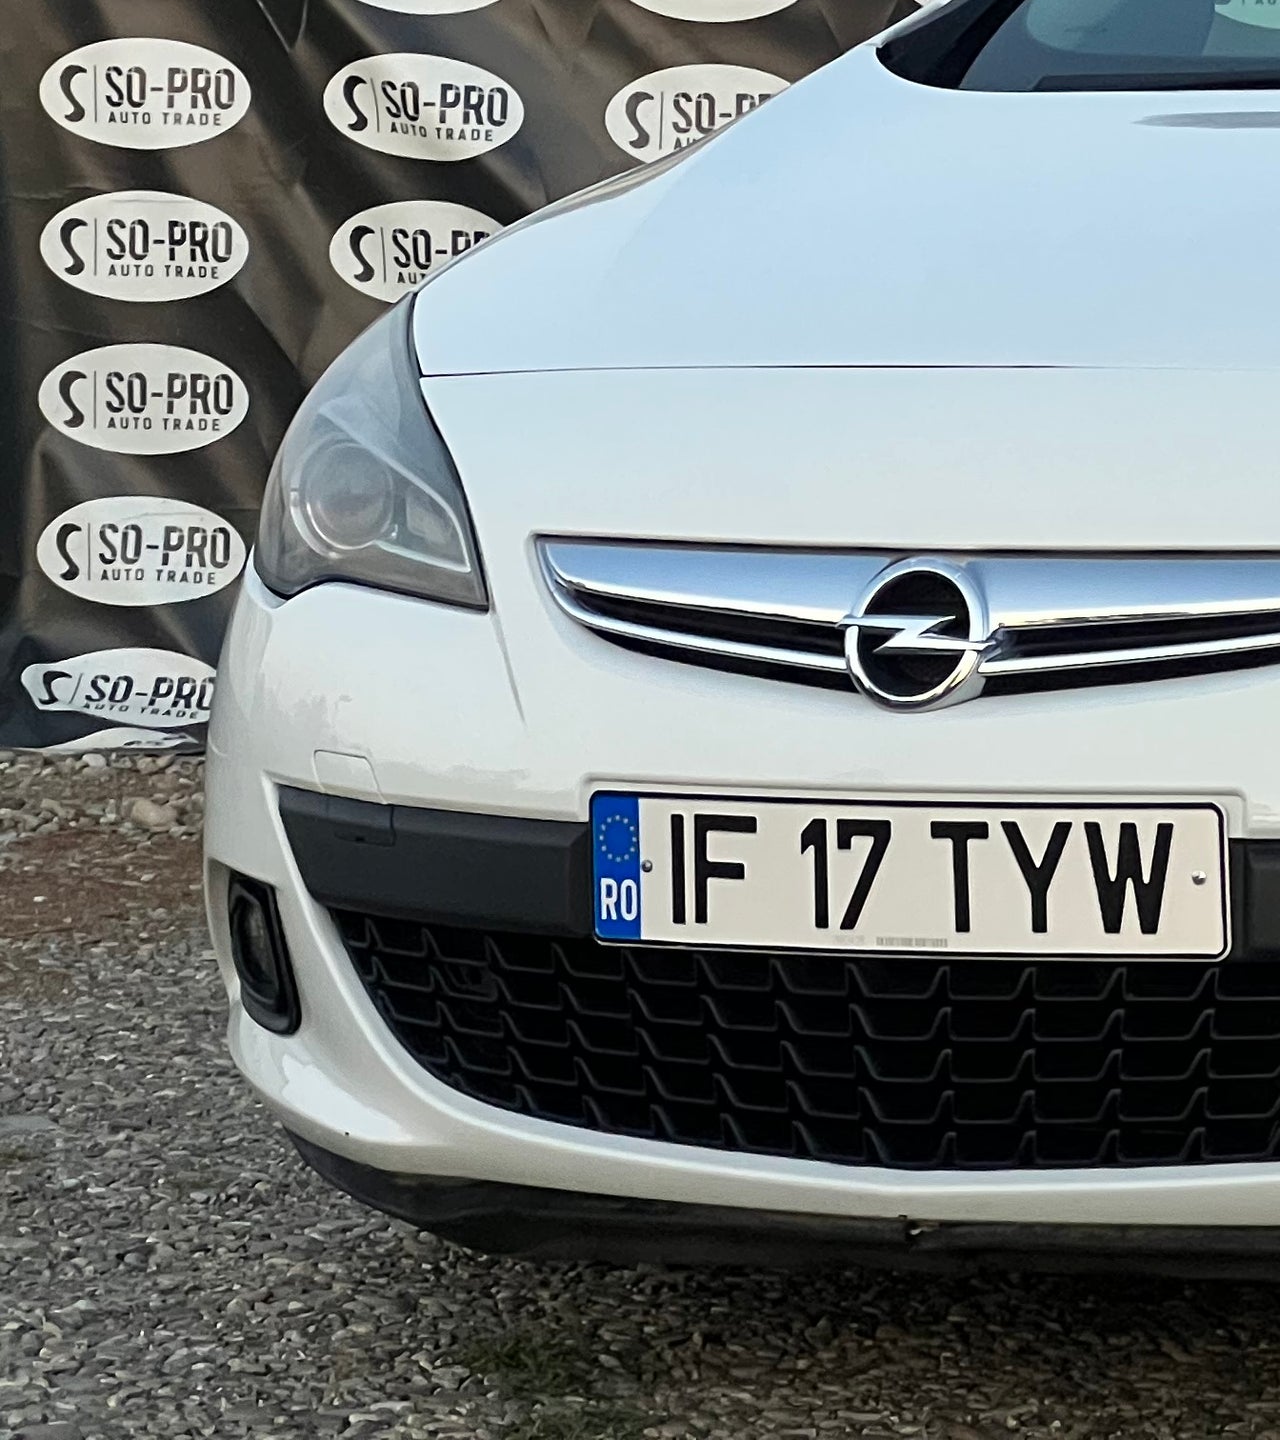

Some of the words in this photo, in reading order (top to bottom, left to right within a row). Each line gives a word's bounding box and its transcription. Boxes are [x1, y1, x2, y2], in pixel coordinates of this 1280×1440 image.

[104, 65, 235, 109] SO-PRO
[379, 79, 509, 127] SO-PRO
[109, 112, 150, 124] AUTO
[163, 112, 221, 126] TRADE
[391, 119, 427, 137] AUTO
[435, 127, 492, 141] TRADE
[672, 92, 773, 134] SO-P
[105, 218, 233, 263] SO-PRO
[392, 228, 490, 270] SO-P
[109, 265, 153, 276] AUTO
[165, 265, 218, 279] TRADE
[104, 372, 234, 415] SO-PRO
[108, 417, 151, 430] AUTO
[163, 418, 219, 431] TRADE
[98, 525, 231, 567] SO-PRO
[101, 569, 144, 581] AUTO
[157, 569, 215, 584] TRADE
[671, 813, 757, 925] IF
[800, 818, 891, 931] 17
[931, 820, 1174, 936] TYW
[600, 877, 637, 922] RO
